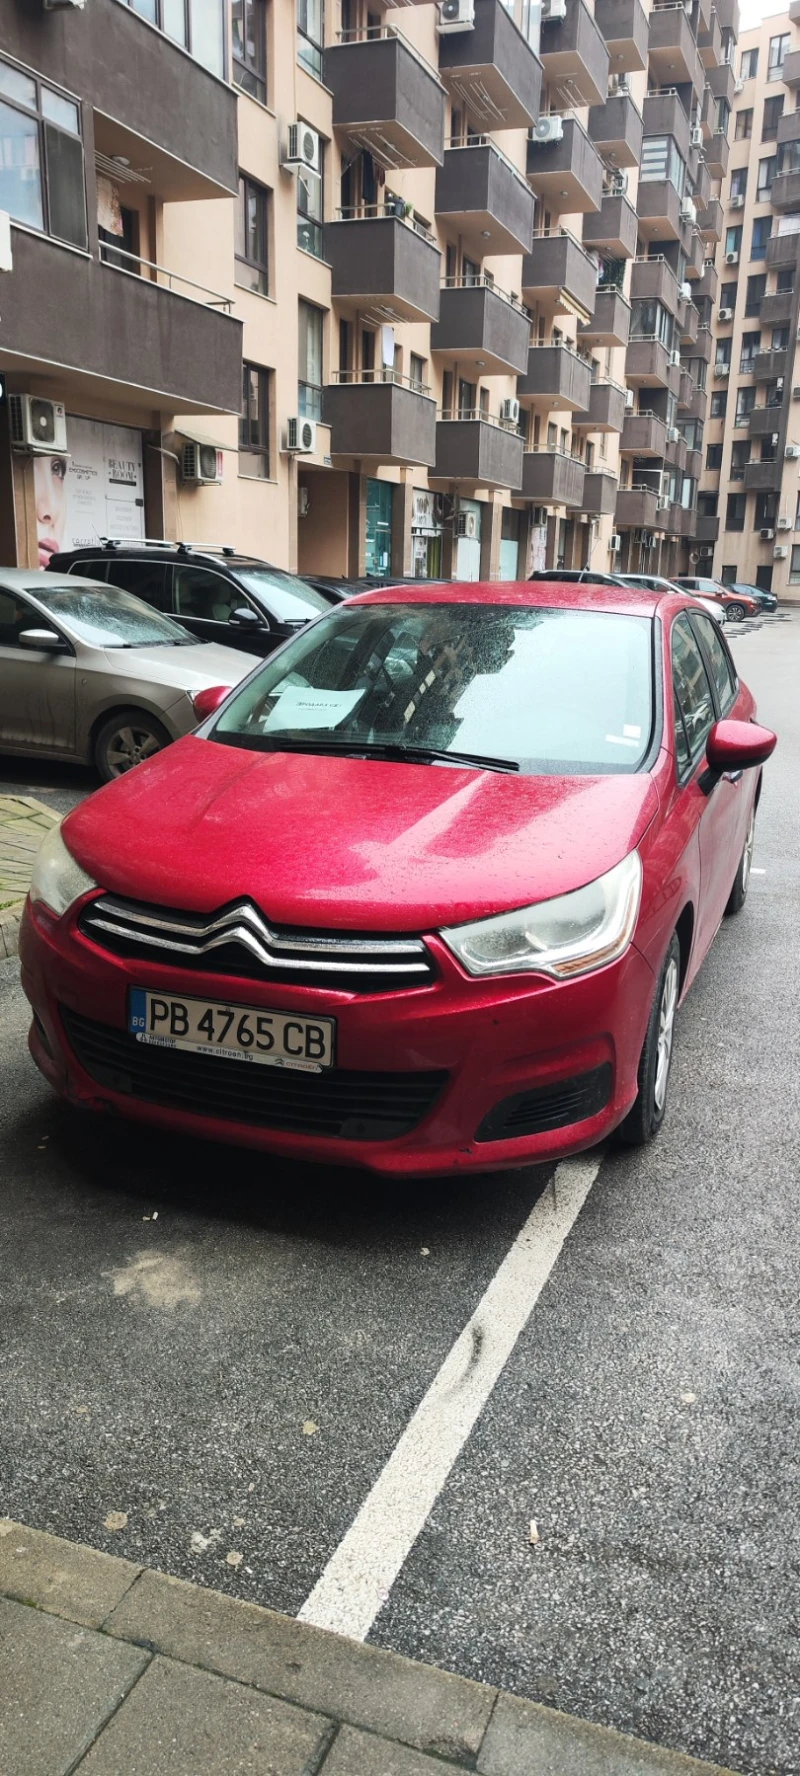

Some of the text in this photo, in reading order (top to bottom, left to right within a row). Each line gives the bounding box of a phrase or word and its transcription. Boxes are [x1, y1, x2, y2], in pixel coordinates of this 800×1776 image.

[108, 459, 135, 472] BEAUTY
[112, 466, 133, 480] ROOM
[132, 1016, 146, 1028] BG
[150, 999, 326, 1060] PB 4765 CB
